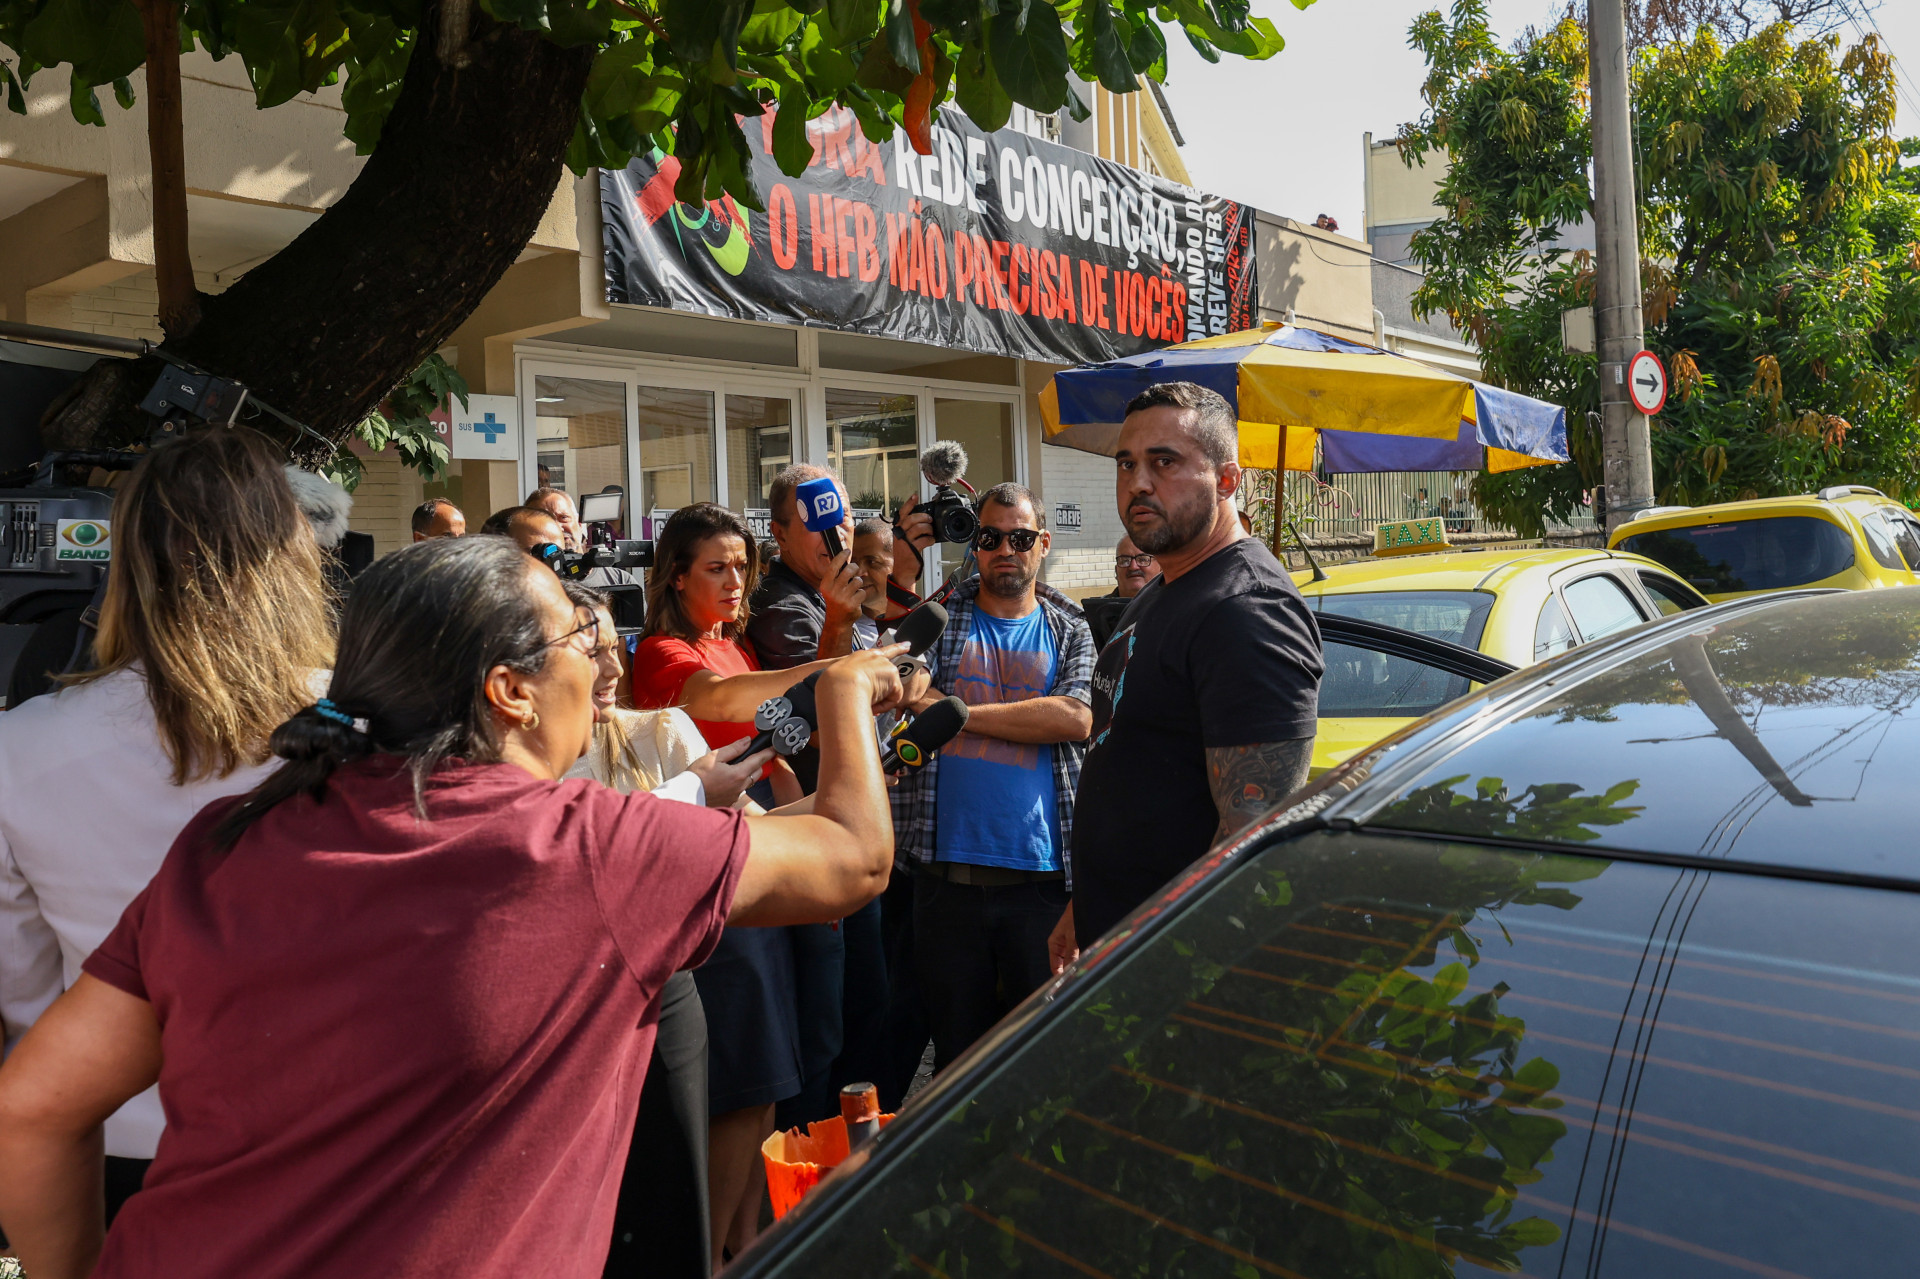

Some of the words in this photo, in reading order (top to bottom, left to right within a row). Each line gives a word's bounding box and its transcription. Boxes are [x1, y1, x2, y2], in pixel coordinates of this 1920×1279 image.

[1000, 147, 1186, 273] CONCEIÇÃO,
[1205, 211, 1225, 264] HFB
[768, 183, 798, 270] O
[808, 193, 880, 283] HFB
[886, 198, 947, 299] NÃO
[954, 230, 1076, 324] PRECISA
[1079, 259, 1110, 330] DE
[1114, 263, 1187, 343] VOCÊS
[1207, 269, 1228, 336] REVE
[458, 422, 473, 432] SUS
[818, 494, 835, 512] R7
[748, 518, 773, 538] GRE
[1056, 509, 1081, 526] GREVE
[1379, 519, 1442, 548] TAXI
[59, 549, 109, 560] BAND
[756, 699, 787, 726] sbt
[778, 723, 810, 756] sbt
